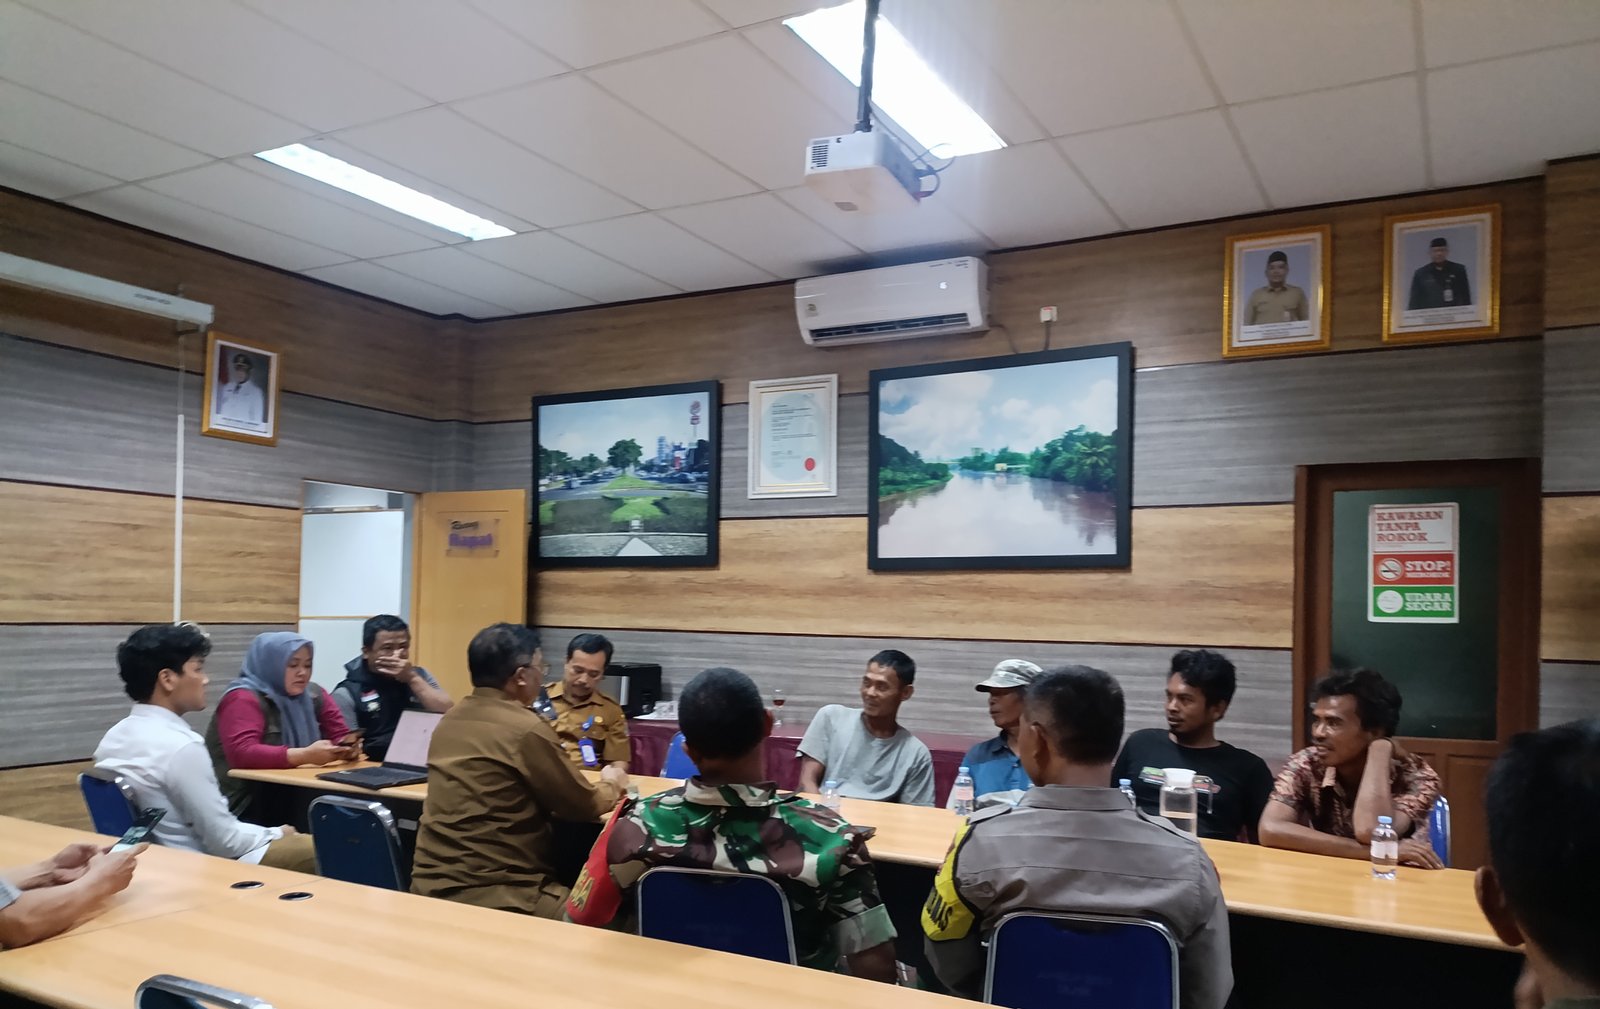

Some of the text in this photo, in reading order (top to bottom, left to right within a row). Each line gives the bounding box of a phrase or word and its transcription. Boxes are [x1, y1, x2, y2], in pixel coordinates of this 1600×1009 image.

[1376, 511, 1444, 521] KAWASAN
[1376, 522, 1421, 531] TANPA
[1376, 532, 1428, 542] ROKOK
[1404, 560, 1451, 571] STOP!
[1404, 592, 1452, 602] UDARA
[1404, 602, 1452, 611] SEGAR
